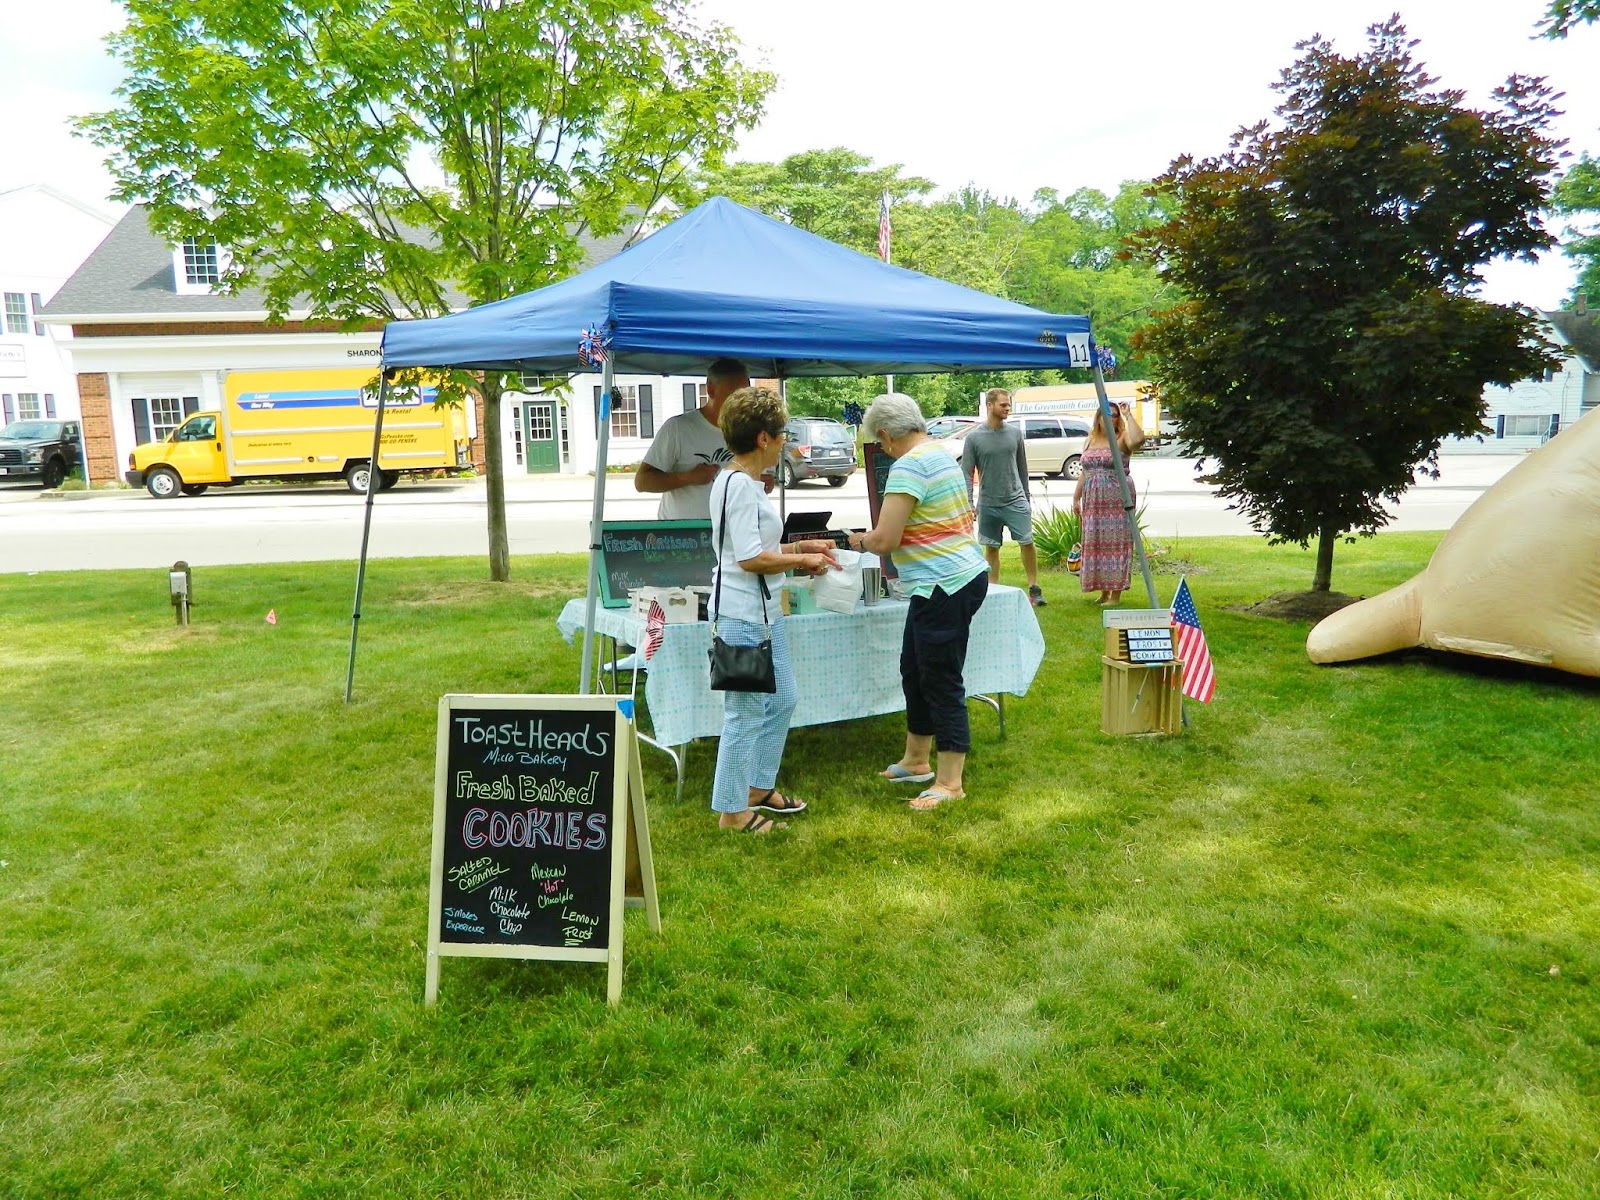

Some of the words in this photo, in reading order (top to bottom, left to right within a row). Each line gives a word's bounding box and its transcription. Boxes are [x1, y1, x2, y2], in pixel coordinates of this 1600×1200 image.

[347, 349, 382, 357] SHARON
[1071, 344, 1089, 362] 11
[1020, 404, 1033, 412] The
[1034, 403, 1076, 411] Greensmith
[1135, 651, 1172, 659] COOKIES
[456, 771, 515, 799] Fresh
[463, 808, 607, 850] COOKIES
[499, 918, 523, 934] Chip
